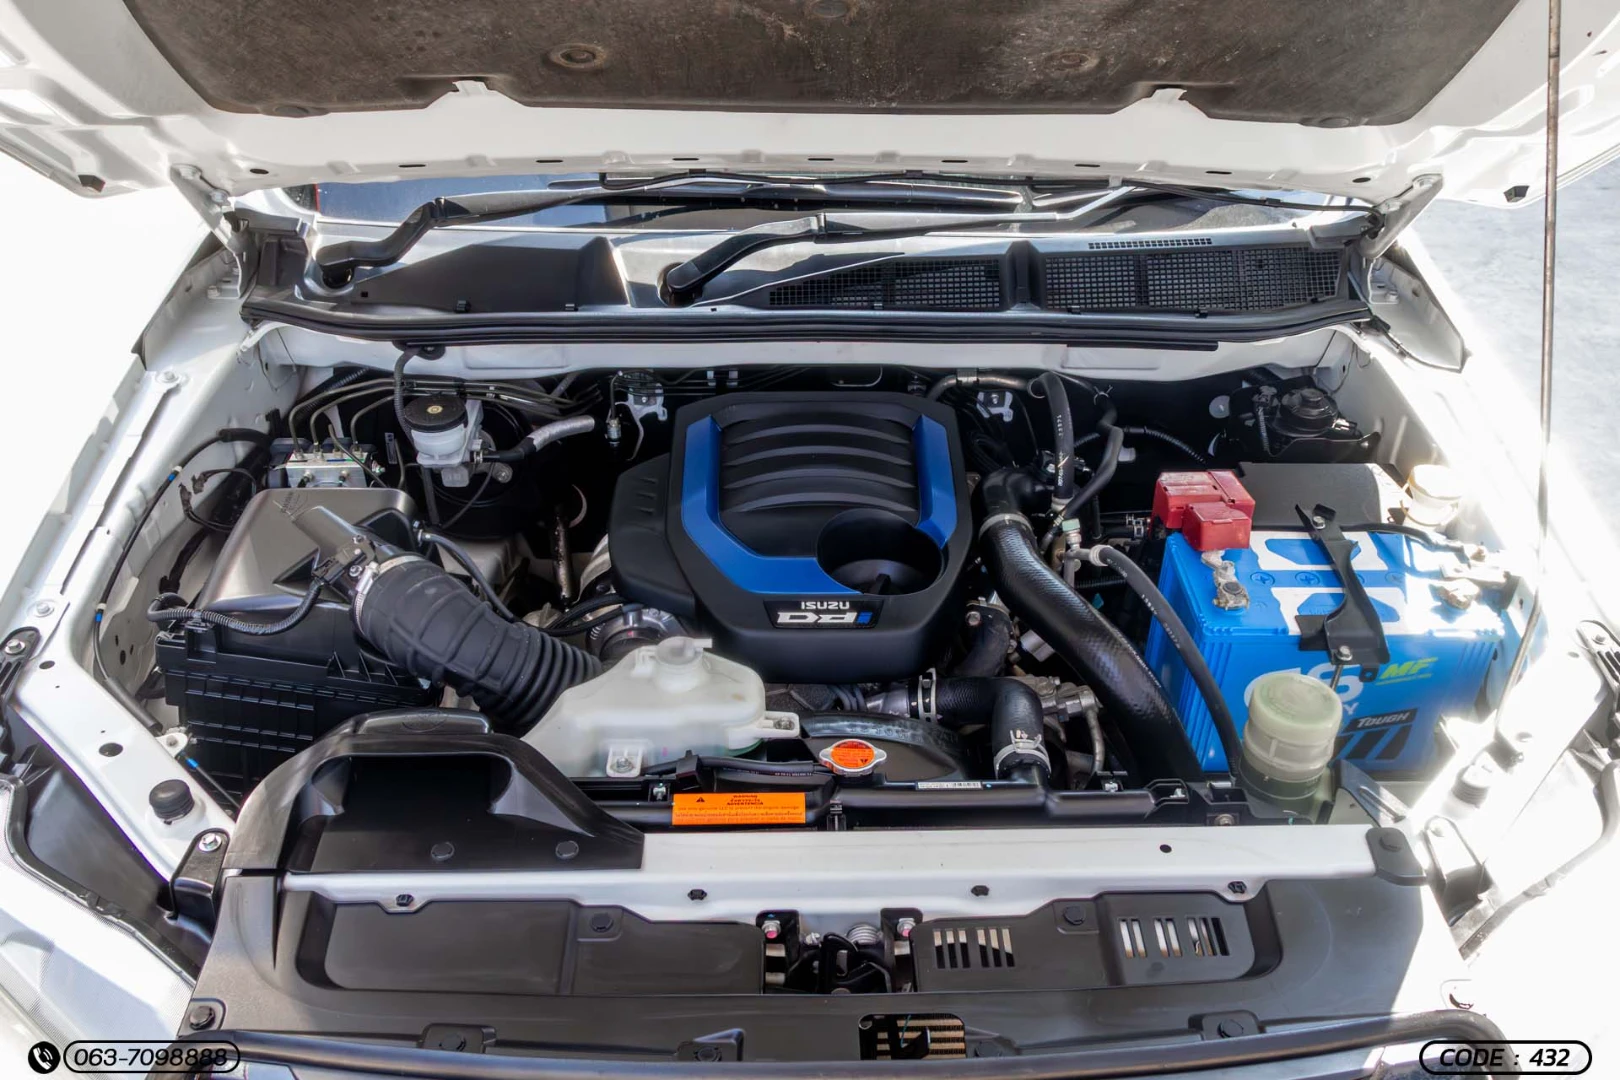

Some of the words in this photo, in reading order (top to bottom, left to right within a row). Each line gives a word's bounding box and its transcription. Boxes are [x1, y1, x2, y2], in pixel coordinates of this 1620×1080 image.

[801, 601, 850, 610] ISUZU
[1380, 657, 1438, 680] MF
[1357, 712, 1410, 728] TOUGH
